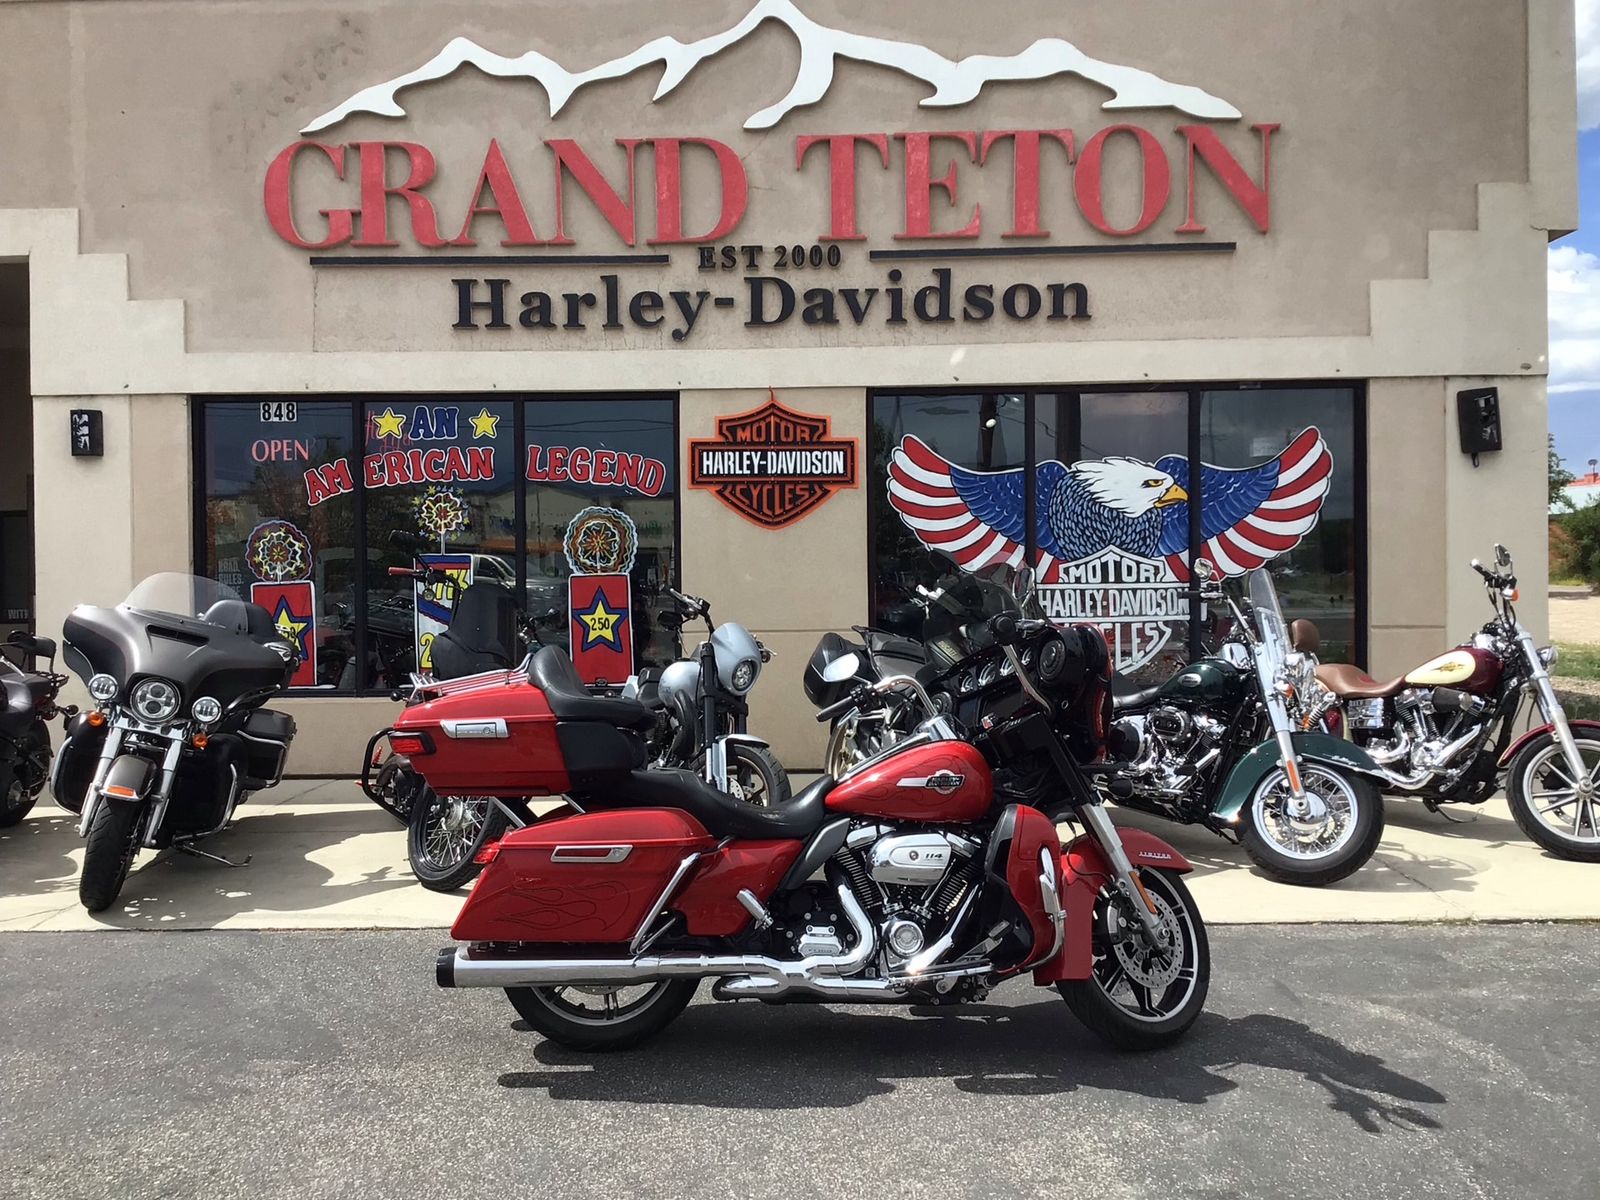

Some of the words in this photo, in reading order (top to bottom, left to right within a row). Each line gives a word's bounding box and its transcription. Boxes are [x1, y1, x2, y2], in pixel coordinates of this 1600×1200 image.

[263, 137, 748, 249] GRAND
[795, 123, 1281, 241] TETON
[698, 245, 764, 269] EST
[773, 245, 841, 268] 2000
[451, 268, 1092, 342] Harley-Davidson
[262, 402, 296, 421] 848
[409, 406, 459, 440] AN
[736, 417, 810, 442] MOTOR
[251, 439, 309, 462] OPEN
[702, 450, 844, 475] HARLEY-DAVIDSON
[525, 444, 666, 497] LEGEND
[735, 483, 811, 514] CYCLES
[1067, 551, 1157, 583] MOTOR
[590, 617, 610, 631] 250
